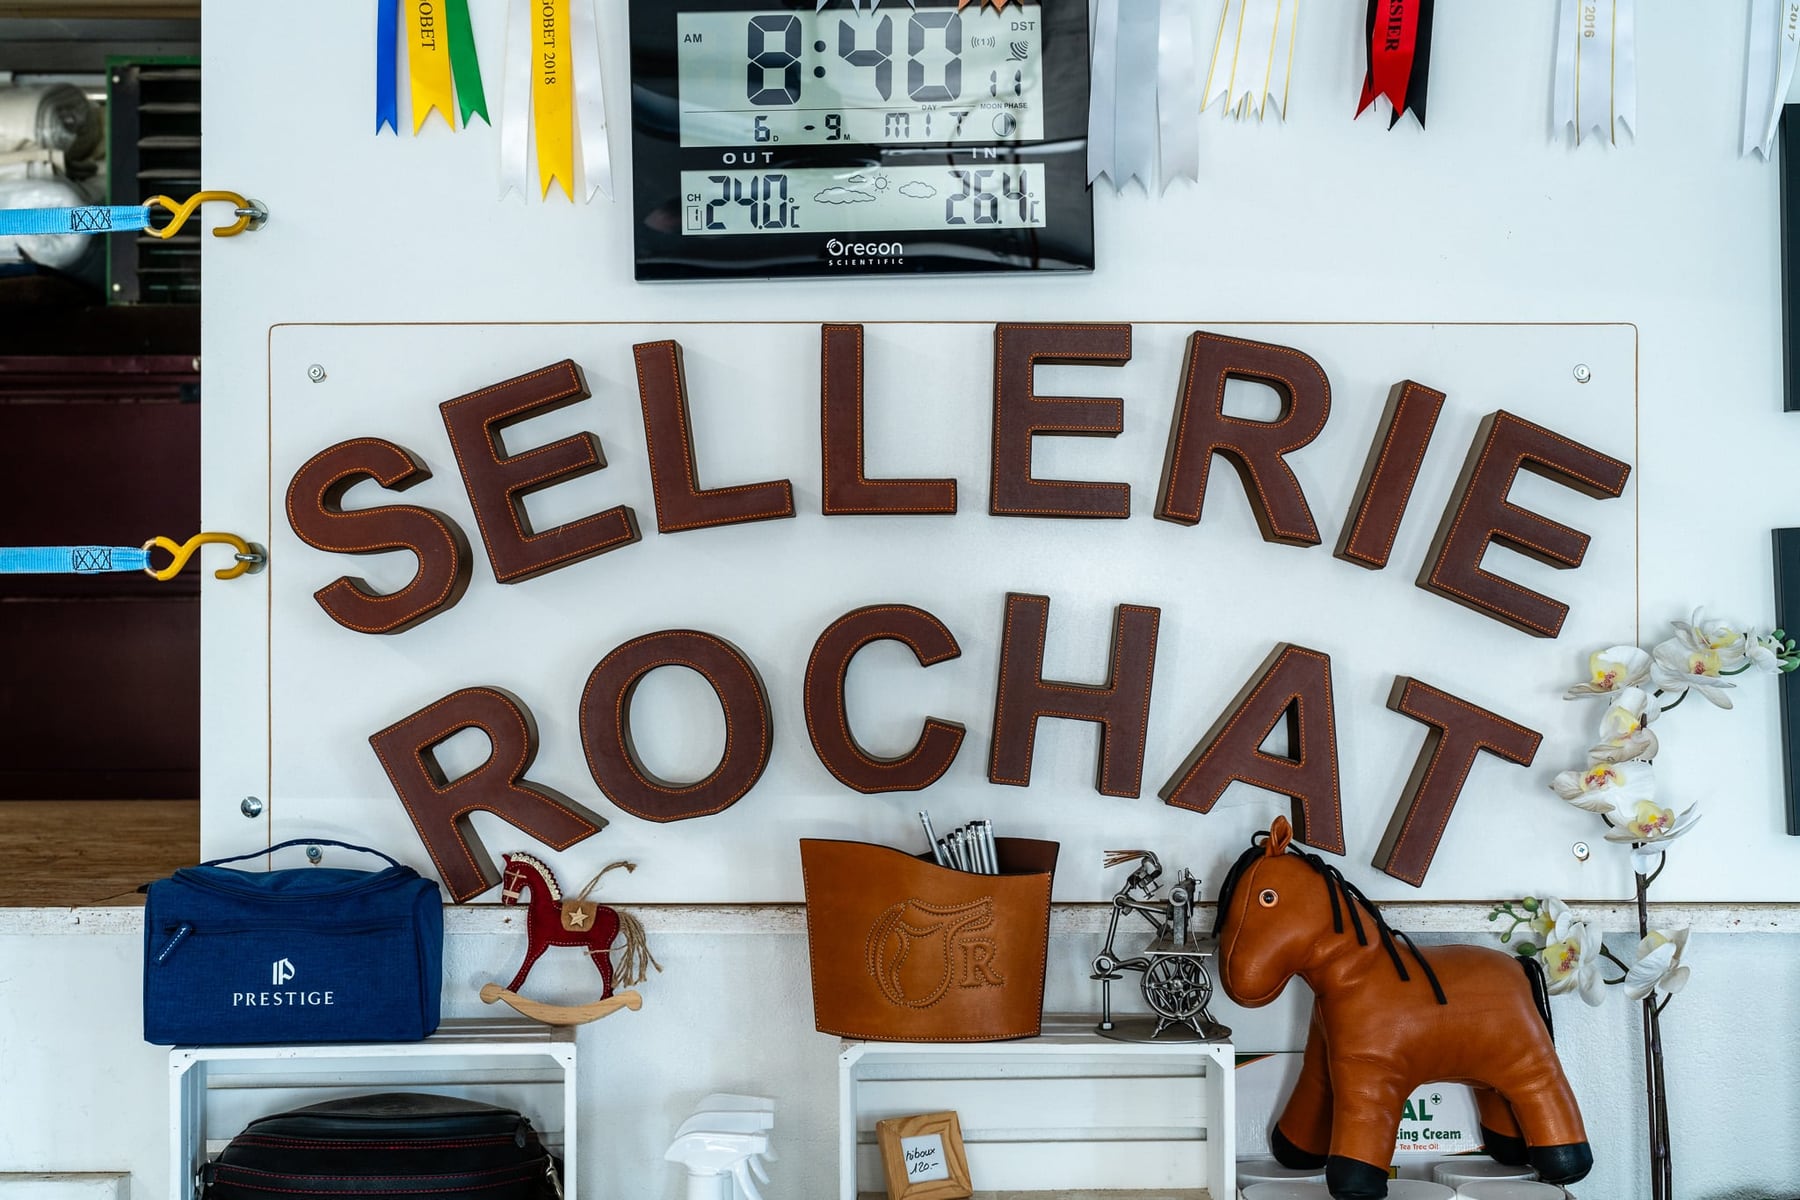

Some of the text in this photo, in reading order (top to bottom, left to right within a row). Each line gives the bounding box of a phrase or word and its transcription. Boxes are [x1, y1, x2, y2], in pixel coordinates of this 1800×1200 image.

[418, 0, 435, 51] OBET
[1011, 21, 1035, 31] DST
[1385, 0, 1404, 51] SIER
[1584, 6, 1596, 38] 2016
[1788, 3, 1799, 42] 2017
[684, 34, 702, 43] AM
[544, 52, 556, 85] 2018
[747, 11, 962, 106] 8:40
[990, 69, 1021, 97] 11
[722, 152, 774, 164] OUT
[972, 147, 997, 159] IN
[687, 194, 701, 202] CH
[826, 238, 903, 256] Oregon
[828, 258, 904, 266] SCIENTIFIC
[285, 323, 1632, 638] SELLERIE
[369, 591, 1543, 905] ROCHAT
[233, 991, 335, 1006] PRESTIGE
[1422, 1128, 1461, 1140] Cream
